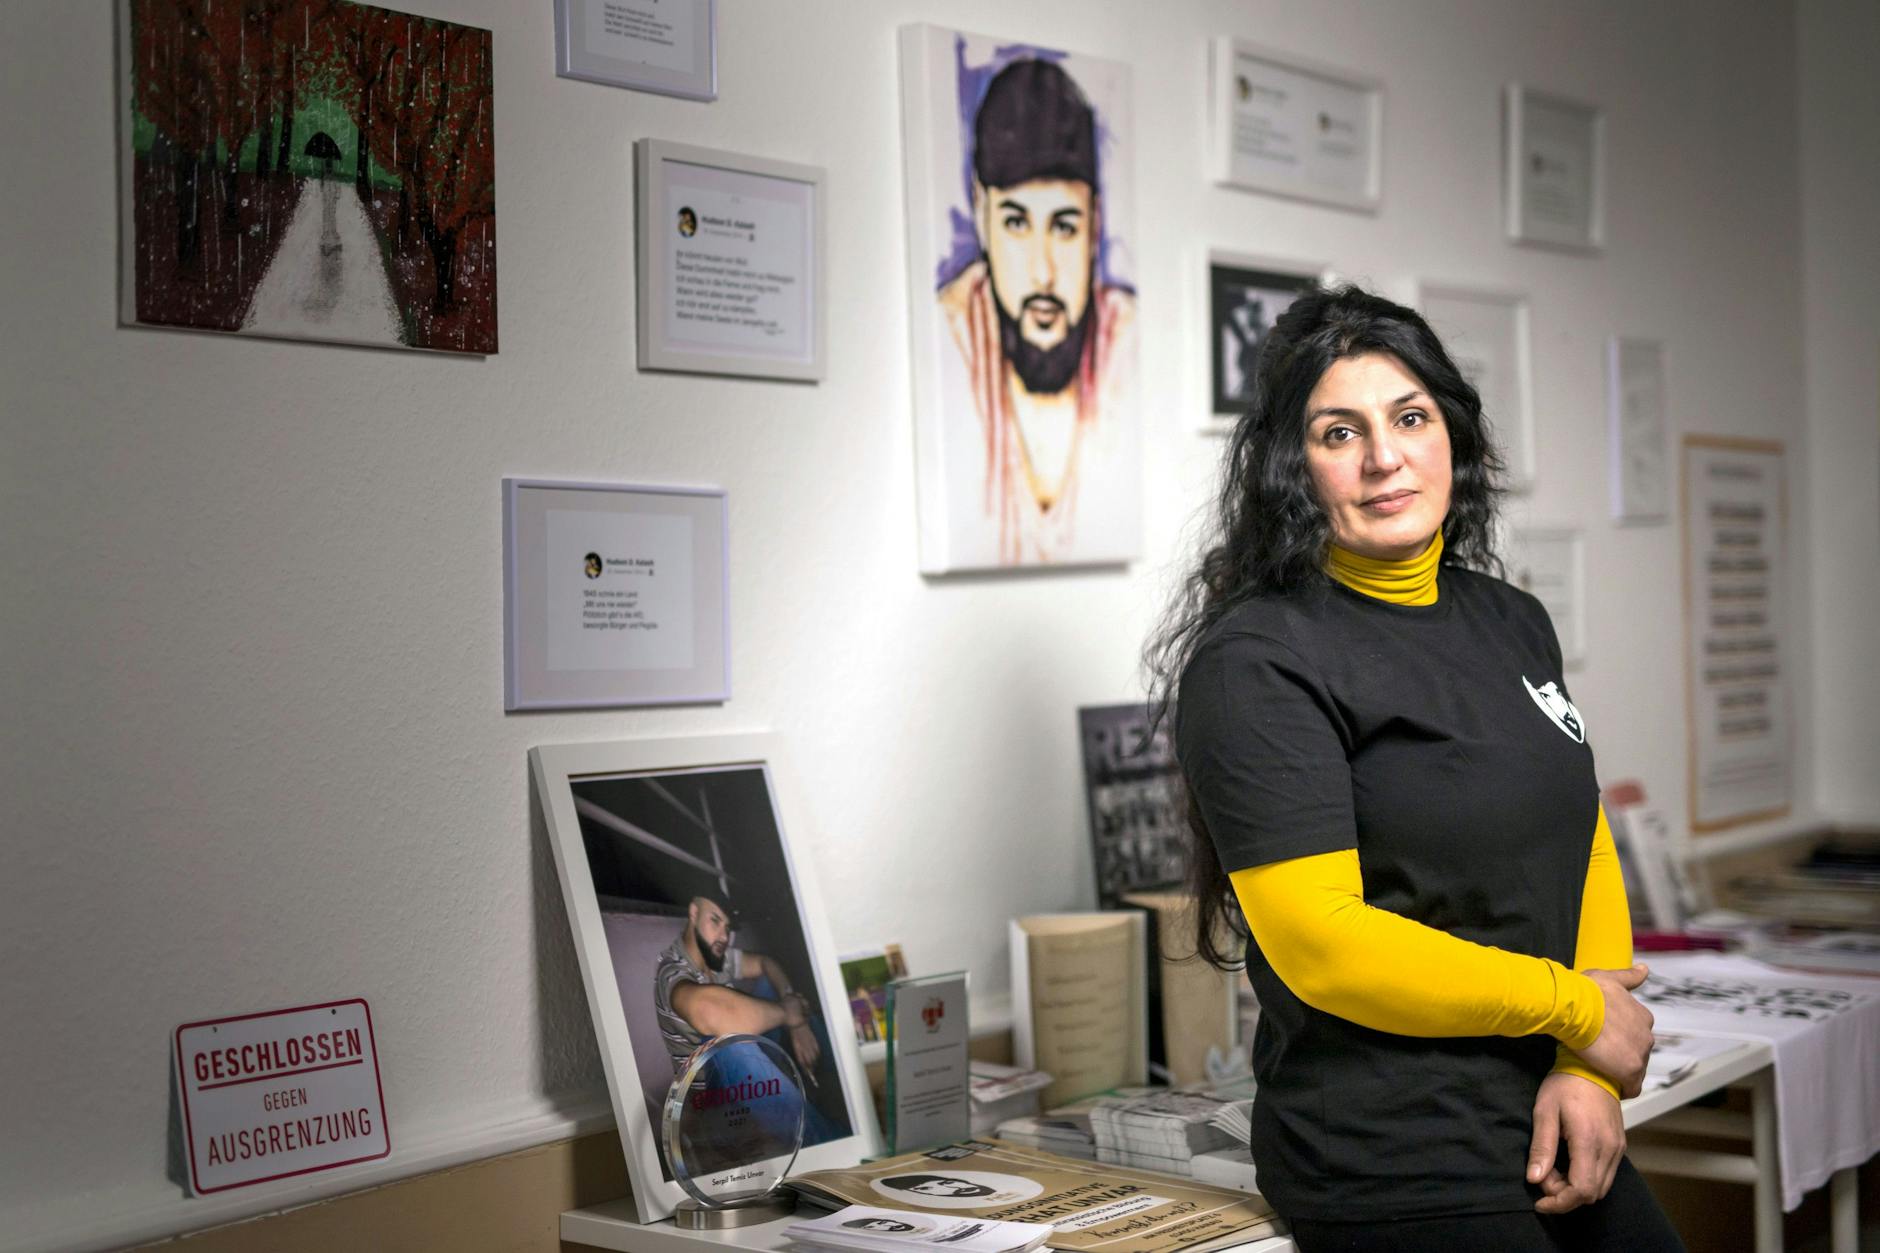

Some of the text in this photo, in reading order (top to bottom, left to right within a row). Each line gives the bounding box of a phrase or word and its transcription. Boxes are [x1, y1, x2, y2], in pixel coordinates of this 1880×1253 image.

[194, 1028, 362, 1082] GESCHLOSSEN
[263, 1088, 308, 1112] GEGEN
[208, 1108, 372, 1167] AUSGRENZUNG
[712, 1170, 765, 1186] Serpil Temiz Unvar
[978, 1182, 1110, 1221] DUNGSINITIATIVE
[1007, 1184, 1150, 1224] RHAT UNVAR
